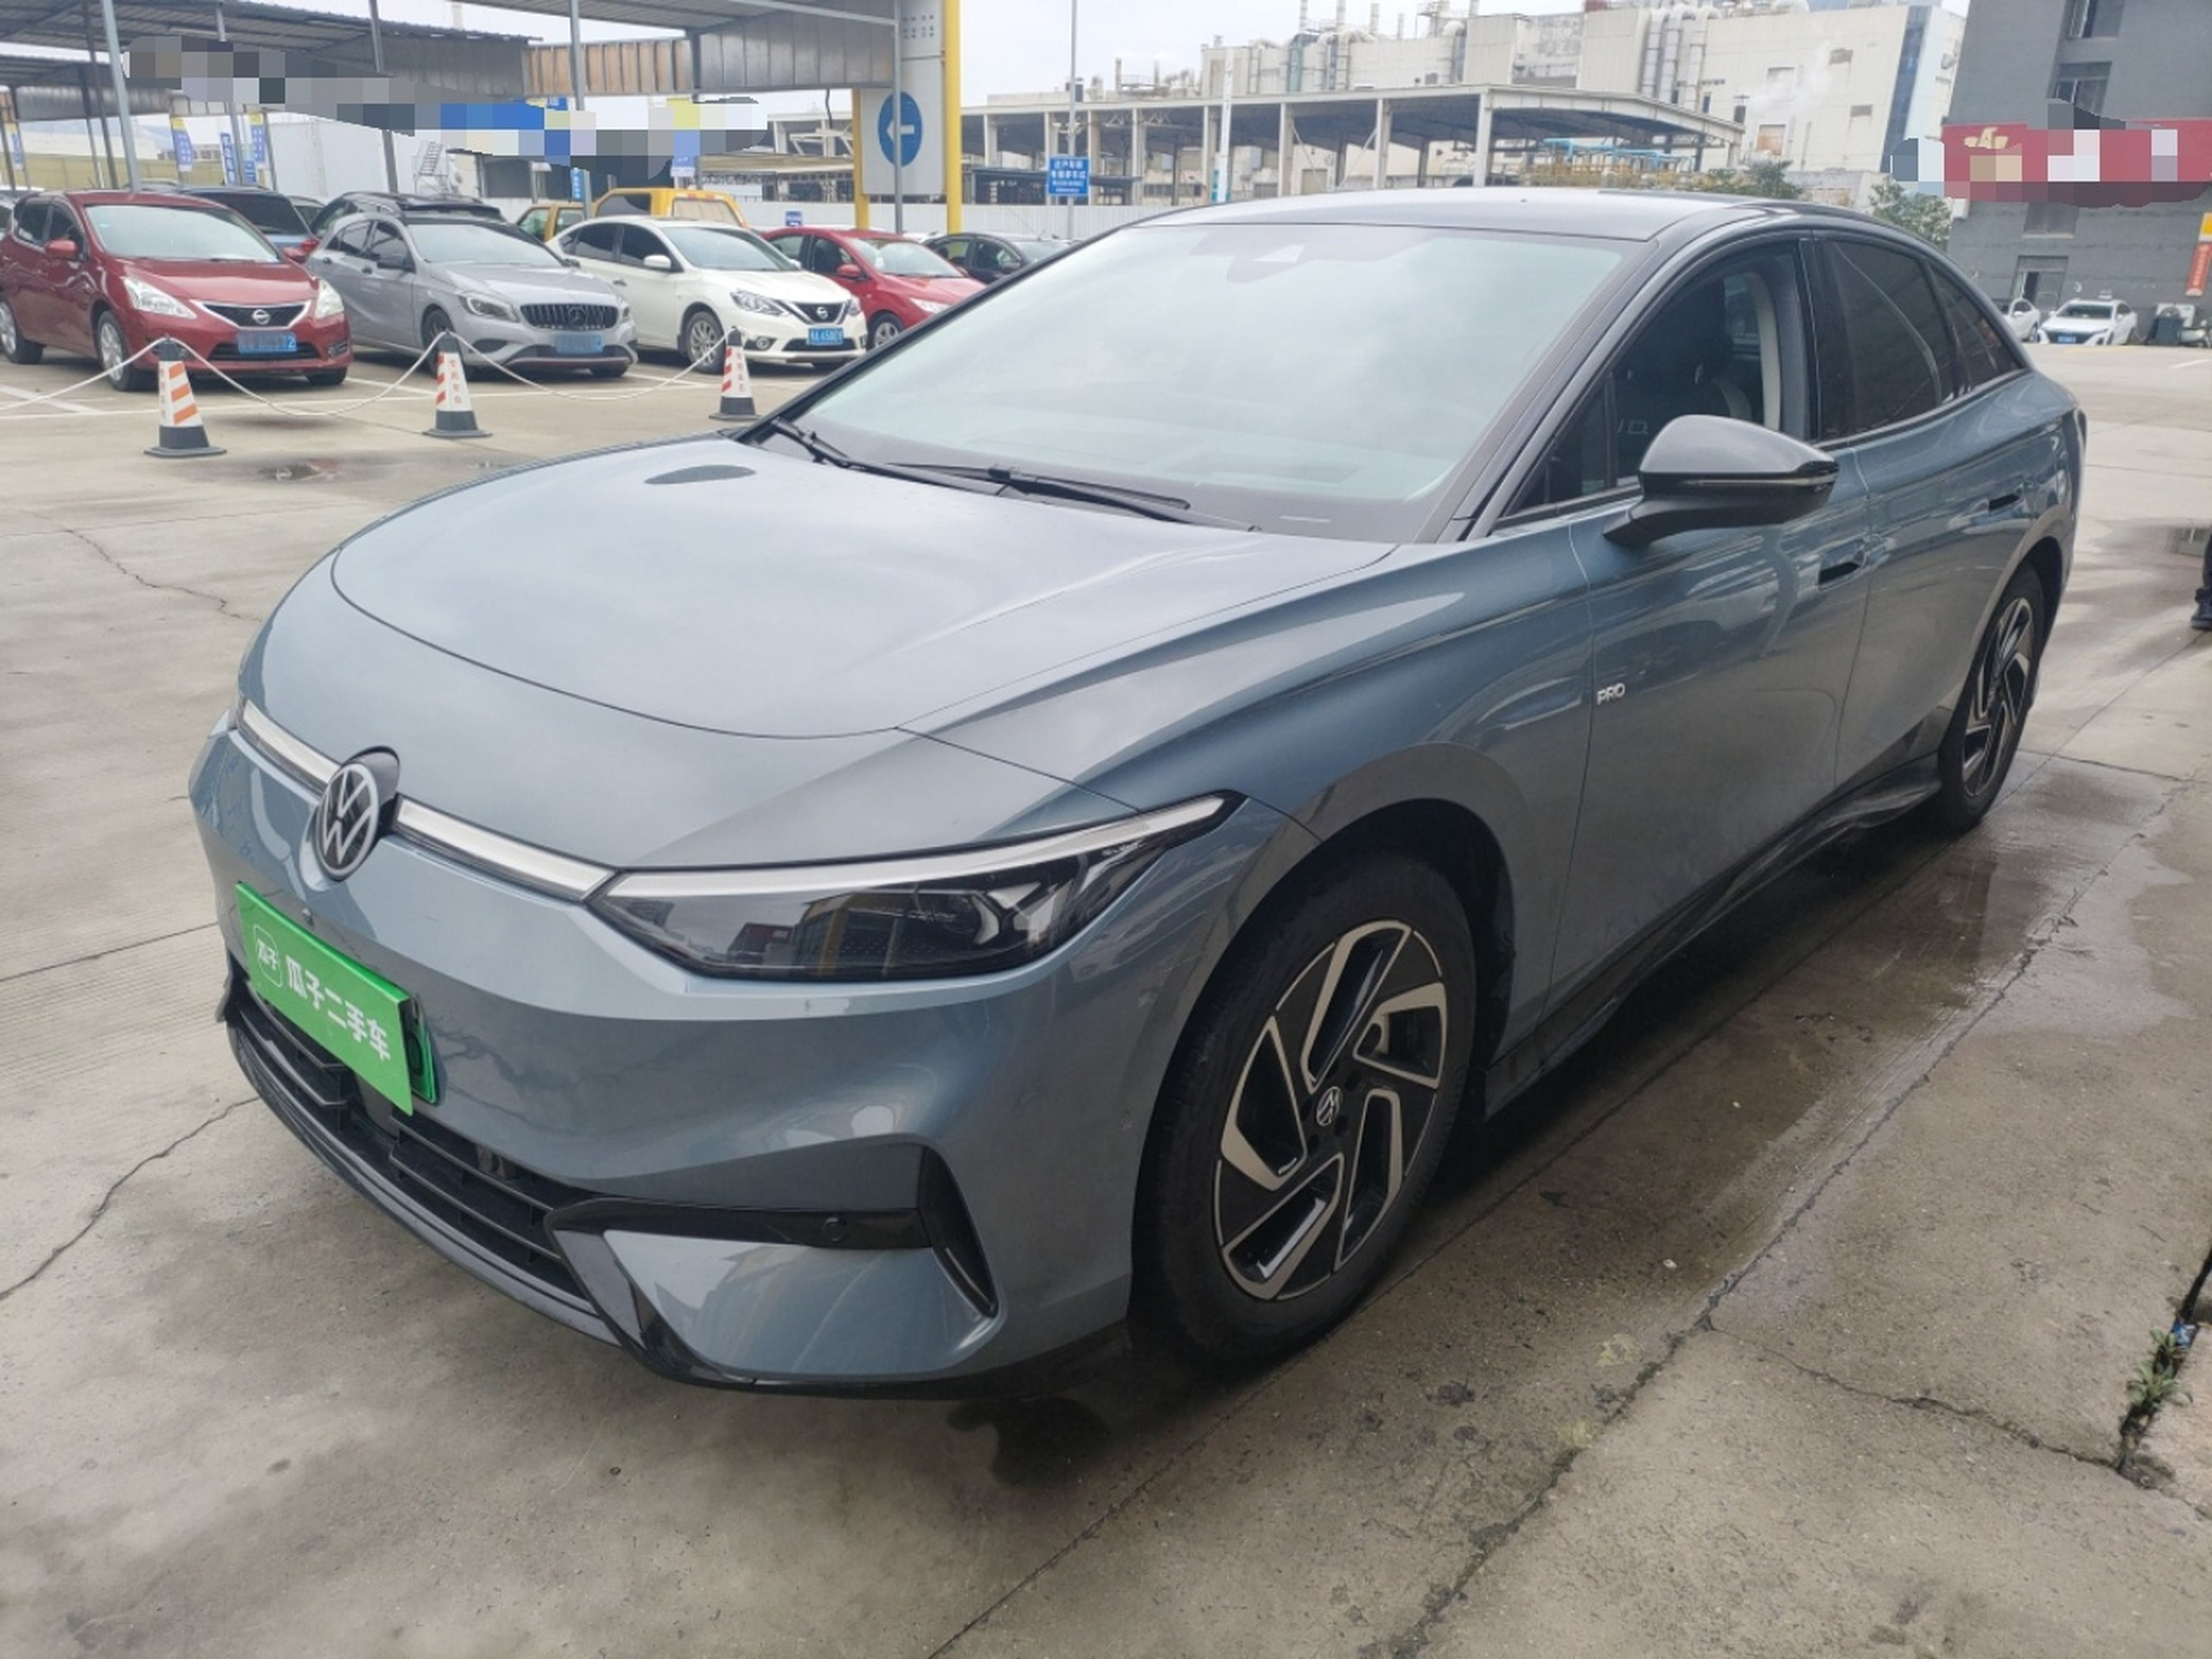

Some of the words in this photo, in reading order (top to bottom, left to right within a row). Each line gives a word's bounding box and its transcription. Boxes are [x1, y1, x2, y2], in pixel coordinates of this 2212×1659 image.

[1597, 683, 1626, 706] PRO
[257, 937, 278, 971] 瓜子
[286, 955, 391, 1060] 瓜子二手车
